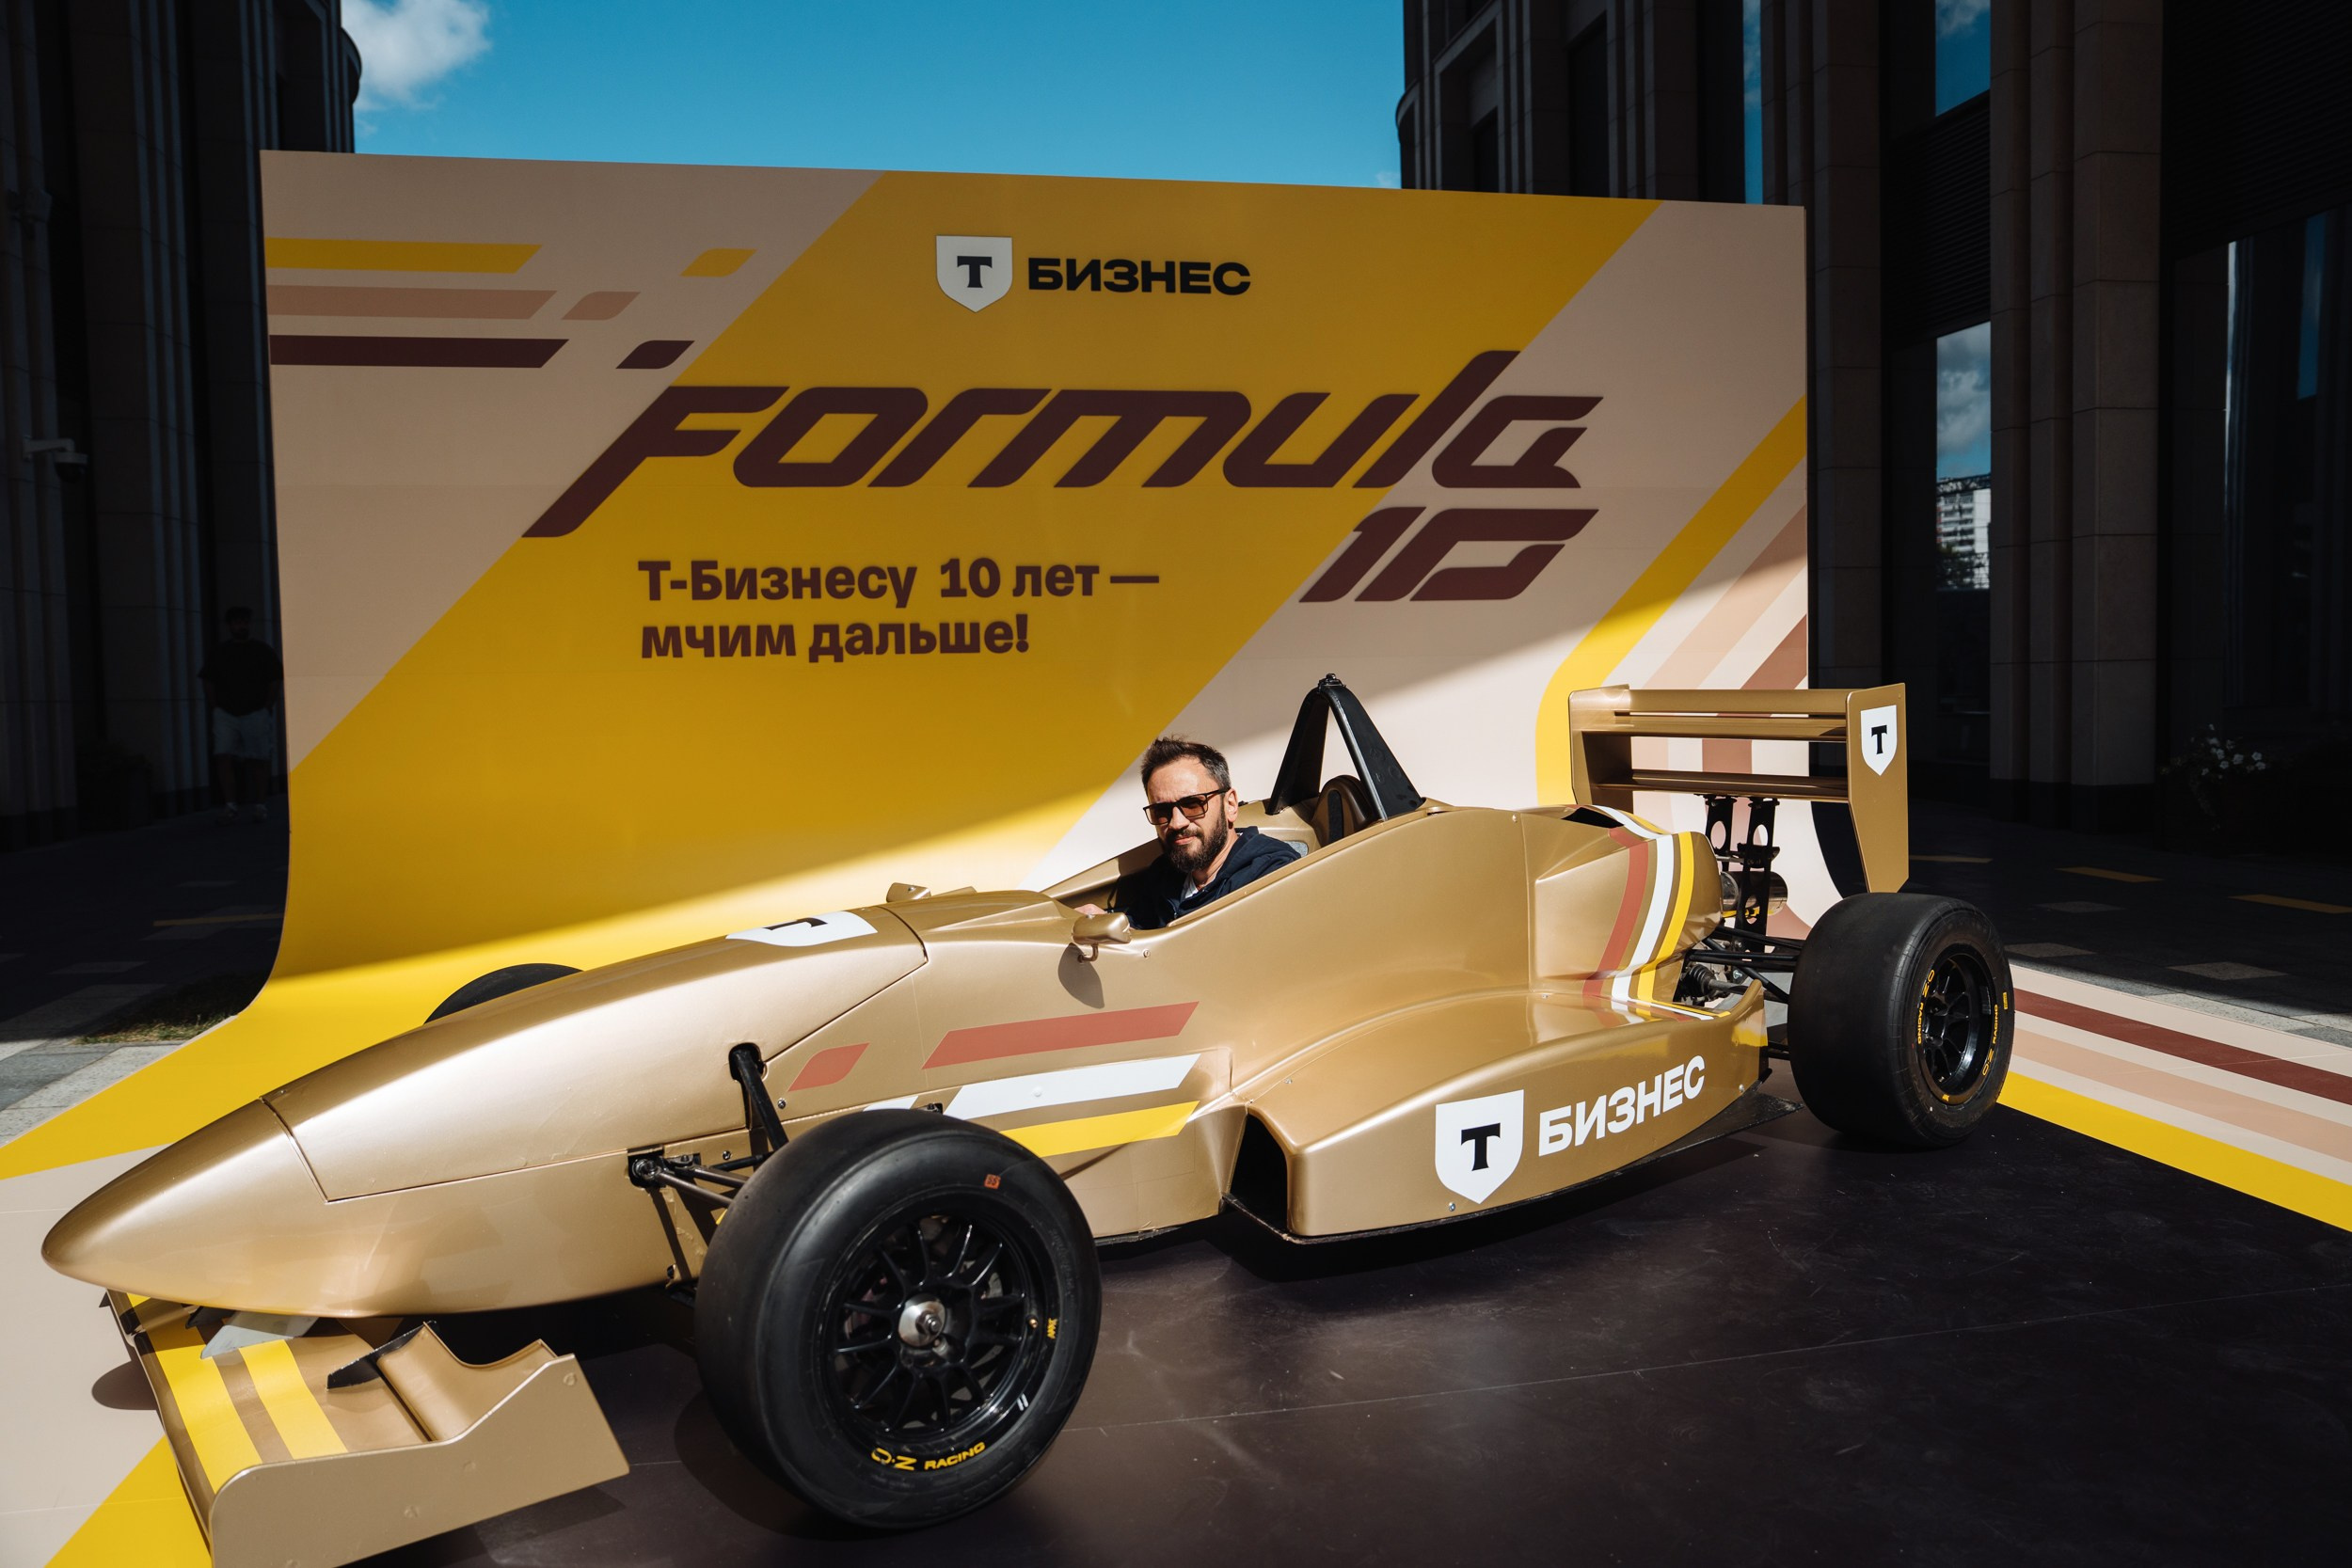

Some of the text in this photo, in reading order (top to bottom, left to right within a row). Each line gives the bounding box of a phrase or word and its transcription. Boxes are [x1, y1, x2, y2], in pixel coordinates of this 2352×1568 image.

[1027, 257, 1251, 296] БИЗНЕС
[520, 349, 1604, 538] Formula
[1298, 506, 1599, 603] 10
[637, 560, 918, 609] Т-Бизнесу
[940, 557, 1001, 598] 10
[1011, 563, 1100, 597] лет
[642, 613, 1029, 663] мчим дальше!
[1538, 1054, 1706, 1157] БИЗНЕС
[924, 1441, 986, 1470] RACING
